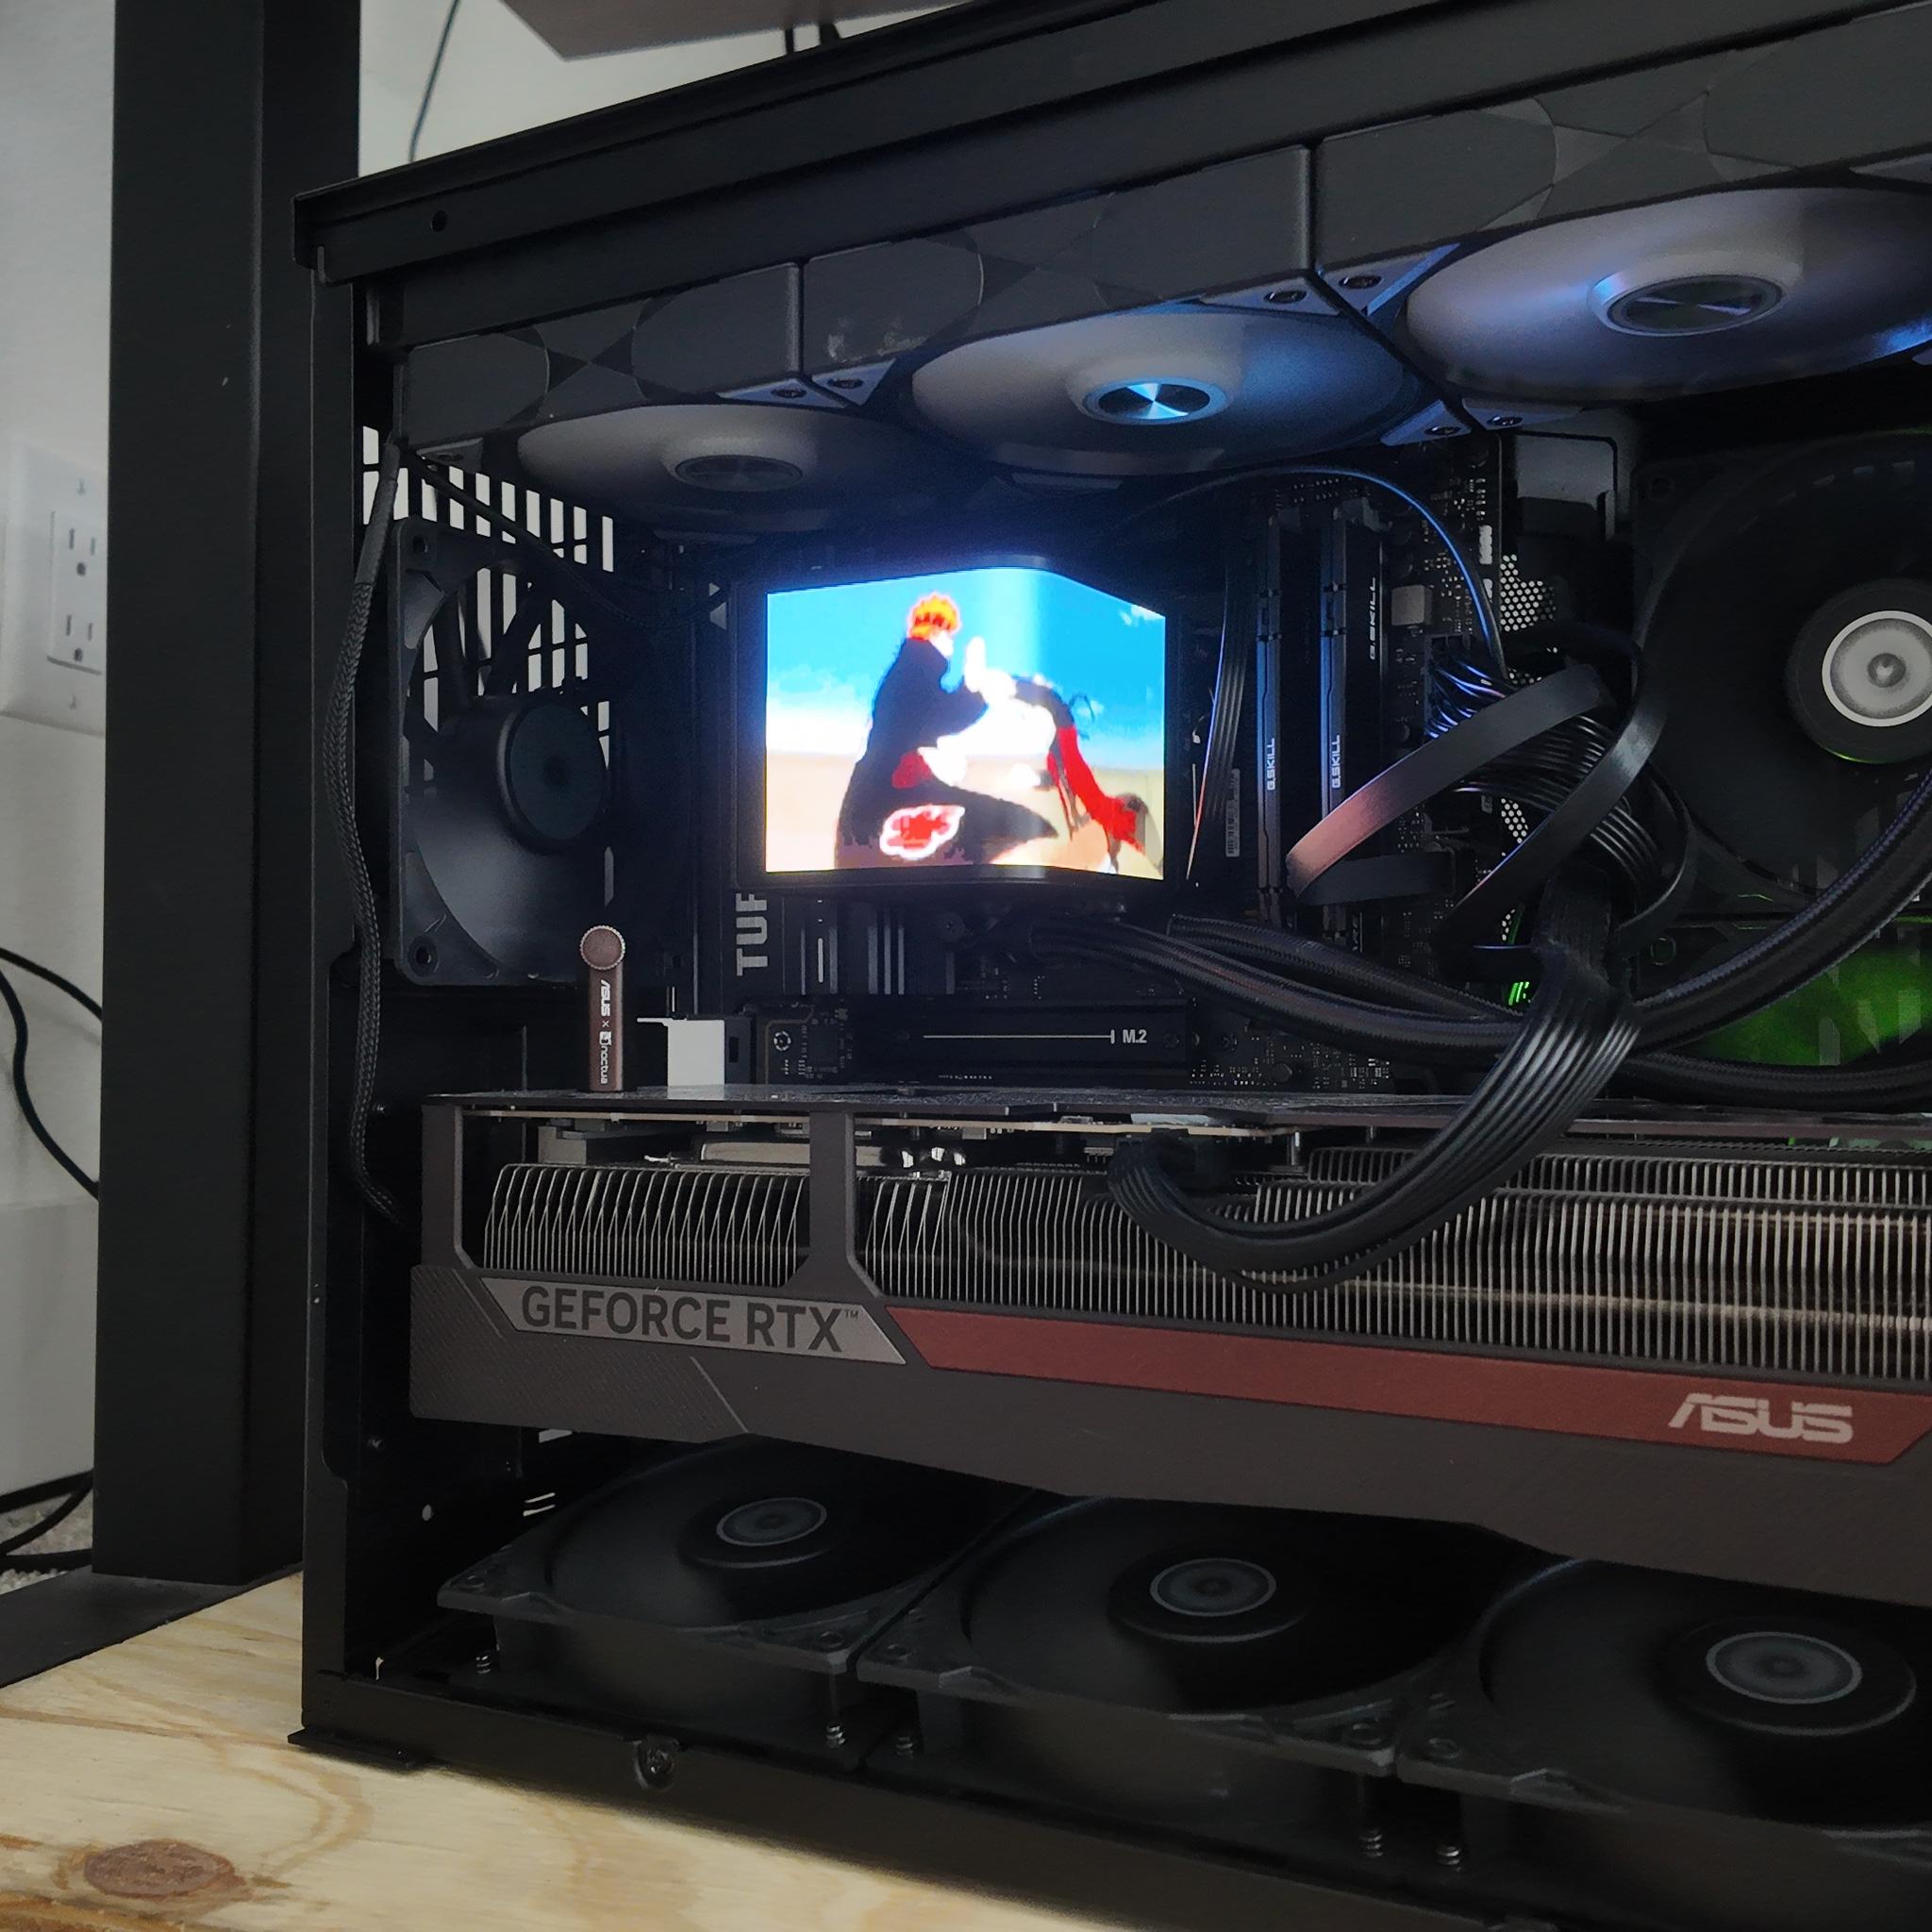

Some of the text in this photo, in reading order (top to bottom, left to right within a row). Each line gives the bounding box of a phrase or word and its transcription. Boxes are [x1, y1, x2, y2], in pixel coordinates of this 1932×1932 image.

[1266, 738, 1276, 791] G.SKILL
[1331, 734, 1341, 789] G.SKILL
[736, 892, 769, 976] TUF
[600, 979, 611, 1017] ASUS
[1122, 1028, 1148, 1044] M.2
[522, 1286, 731, 1342] GEFORCE
[1667, 1393, 1854, 1443] ASUS
